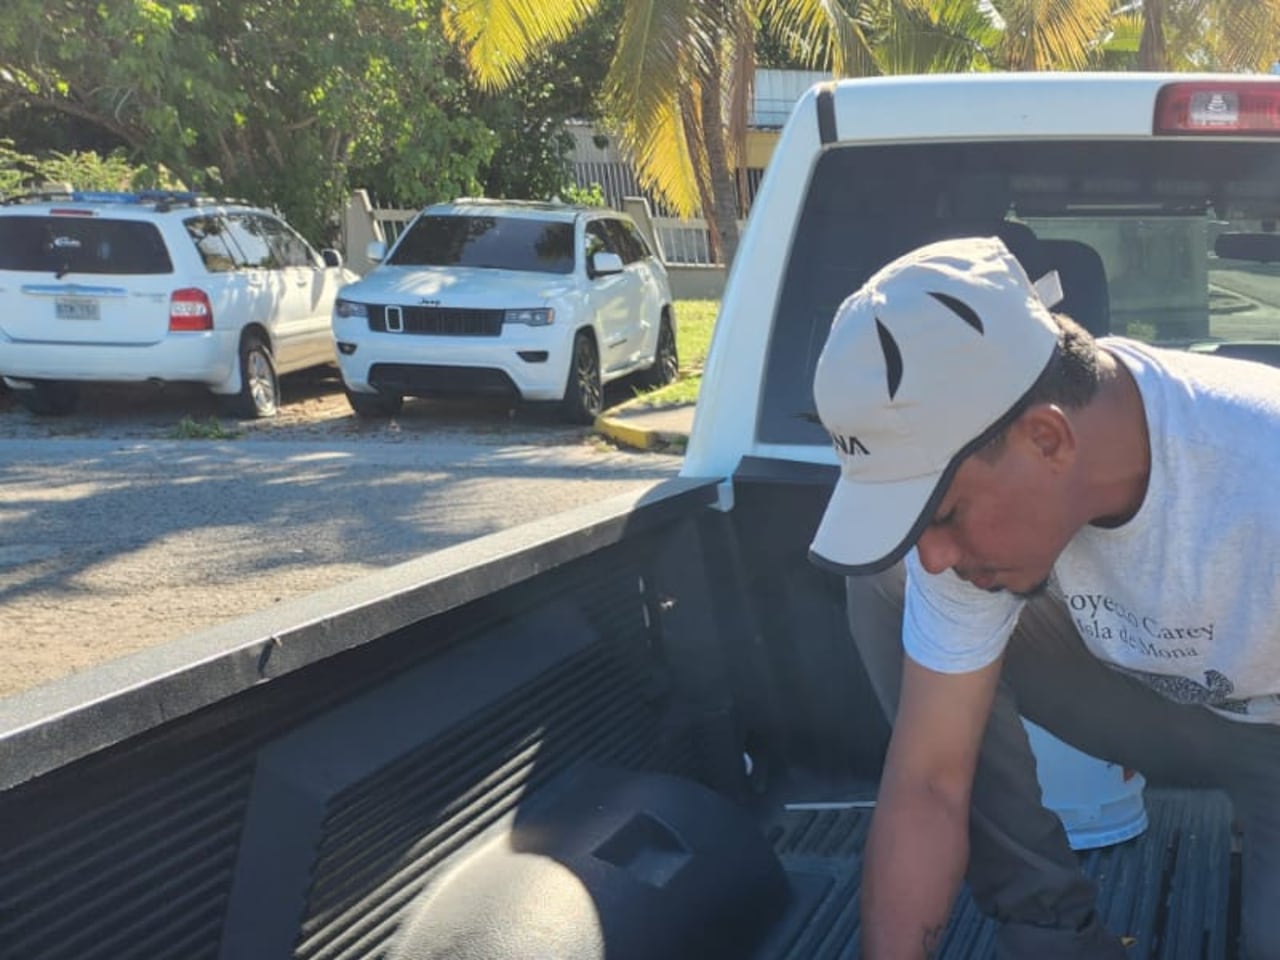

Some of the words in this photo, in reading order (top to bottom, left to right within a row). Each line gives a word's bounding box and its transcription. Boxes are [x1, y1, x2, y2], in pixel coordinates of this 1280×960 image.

[1076, 618, 1112, 640] Isla
[1139, 638, 1199, 659] Mona
[1143, 616, 1214, 641] Carey
